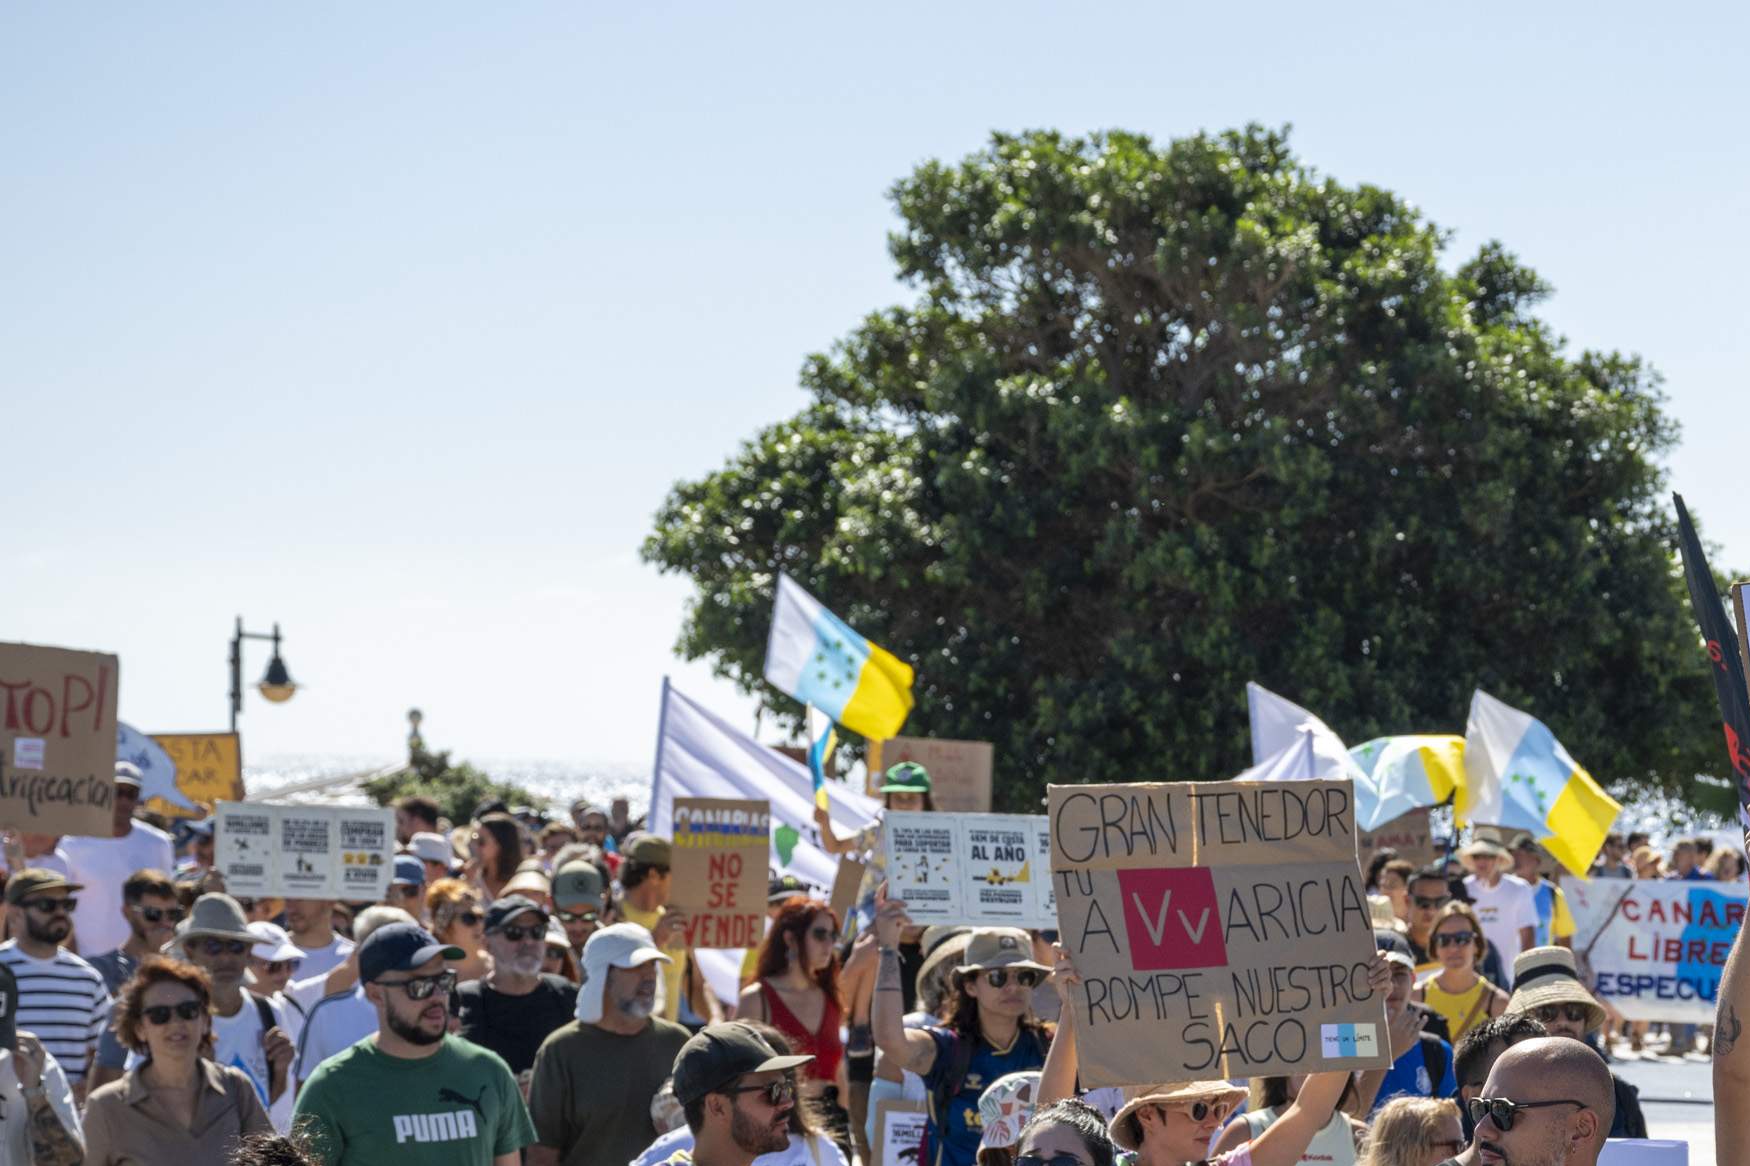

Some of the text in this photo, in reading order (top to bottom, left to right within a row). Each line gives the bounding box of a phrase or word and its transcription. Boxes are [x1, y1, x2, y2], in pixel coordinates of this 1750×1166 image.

[1054, 787, 1349, 863] GRAN TENEDOR
[708, 852, 744, 881] NO
[1056, 869, 1097, 897] TU
[706, 881, 739, 910] SE
[681, 913, 759, 949] VENDE
[1084, 961, 1374, 1025] ROMPE NUESTRO
[1182, 1018, 1307, 1071] SACO
[393, 1109, 478, 1143] PUMA
